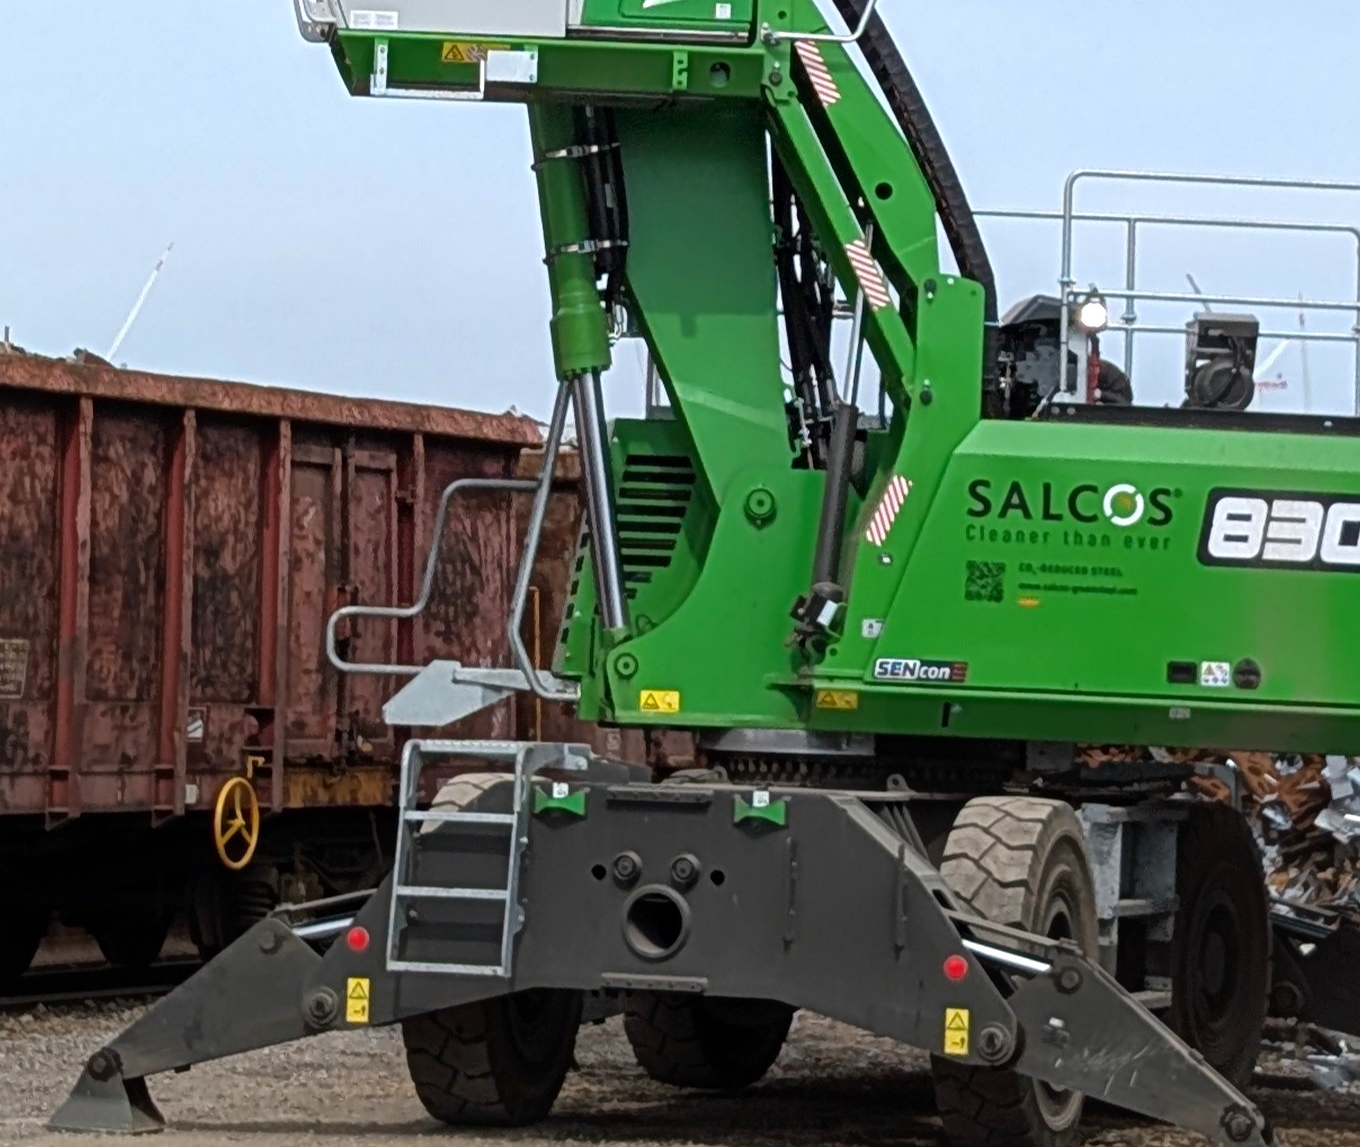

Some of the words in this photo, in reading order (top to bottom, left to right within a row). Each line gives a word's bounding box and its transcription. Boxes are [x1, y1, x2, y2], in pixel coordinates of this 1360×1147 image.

[965, 523, 1051, 545] Cleaner
[1063, 529, 1112, 547] than
[1123, 533, 1172, 550] ever
